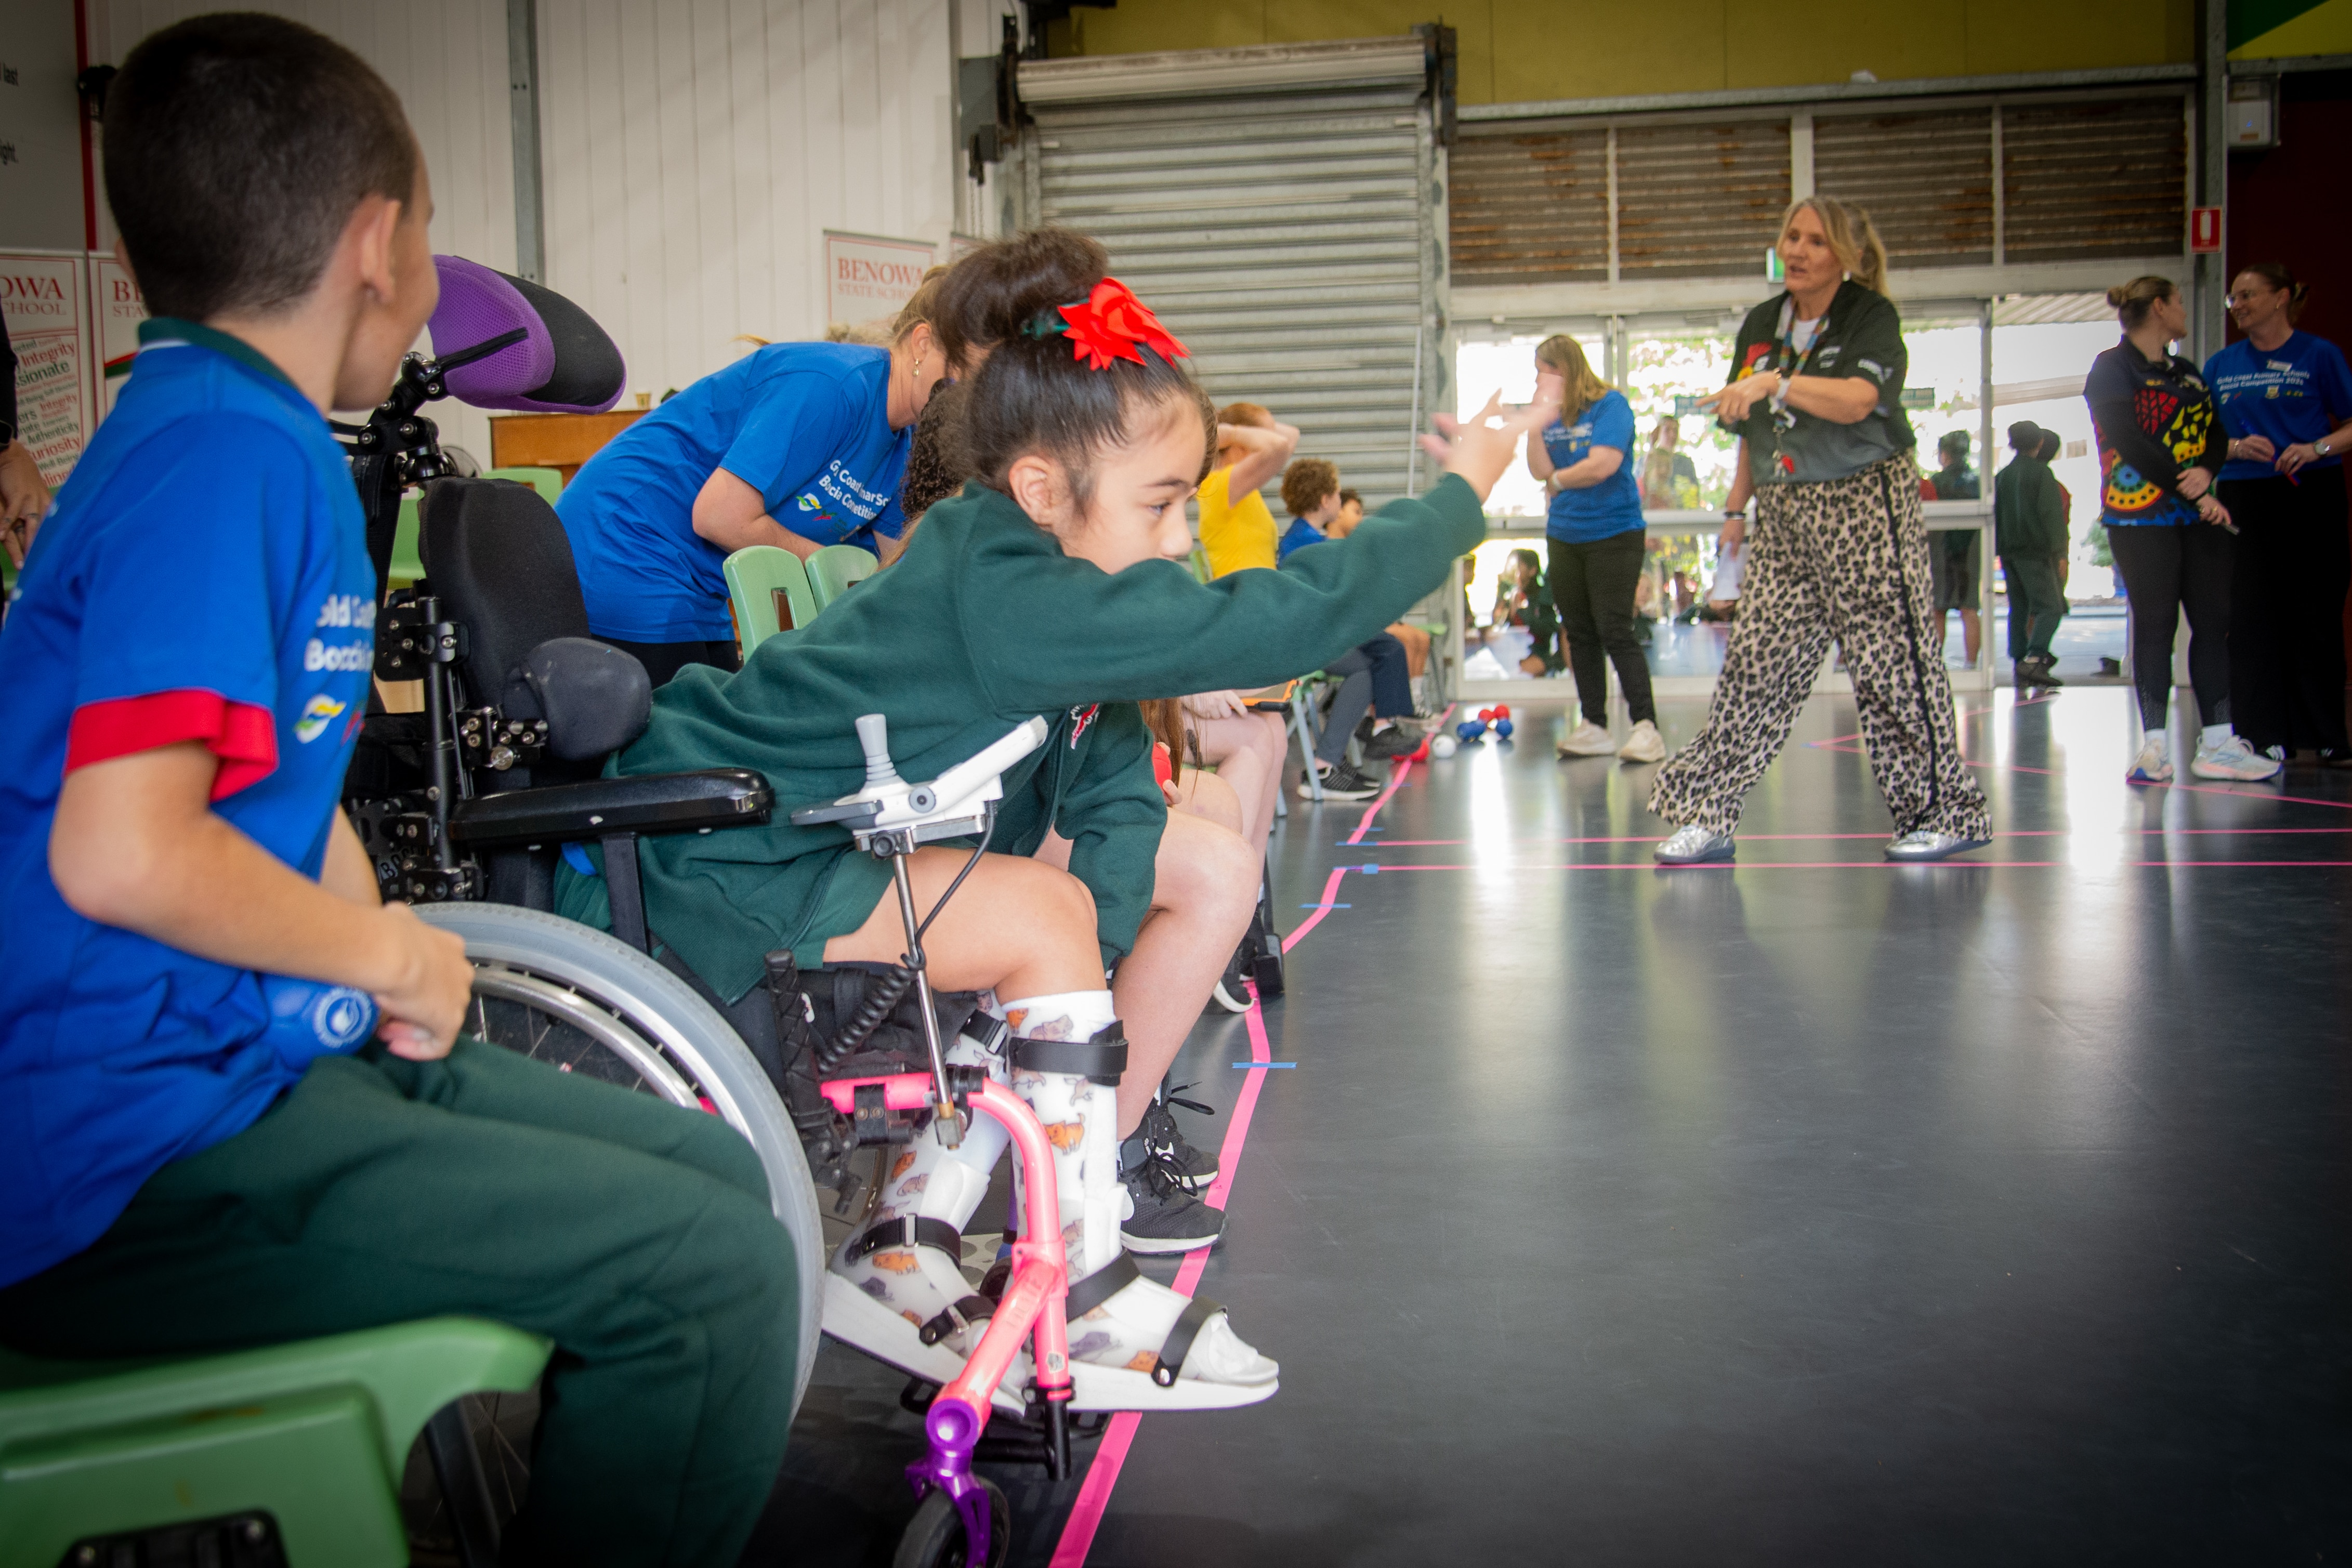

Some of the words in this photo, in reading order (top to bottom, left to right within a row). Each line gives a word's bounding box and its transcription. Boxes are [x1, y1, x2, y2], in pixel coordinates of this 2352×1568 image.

[838, 256, 923, 287] BENOWA
[21, 342, 75, 367] Integrity
[28, 437, 81, 460] uriosity
